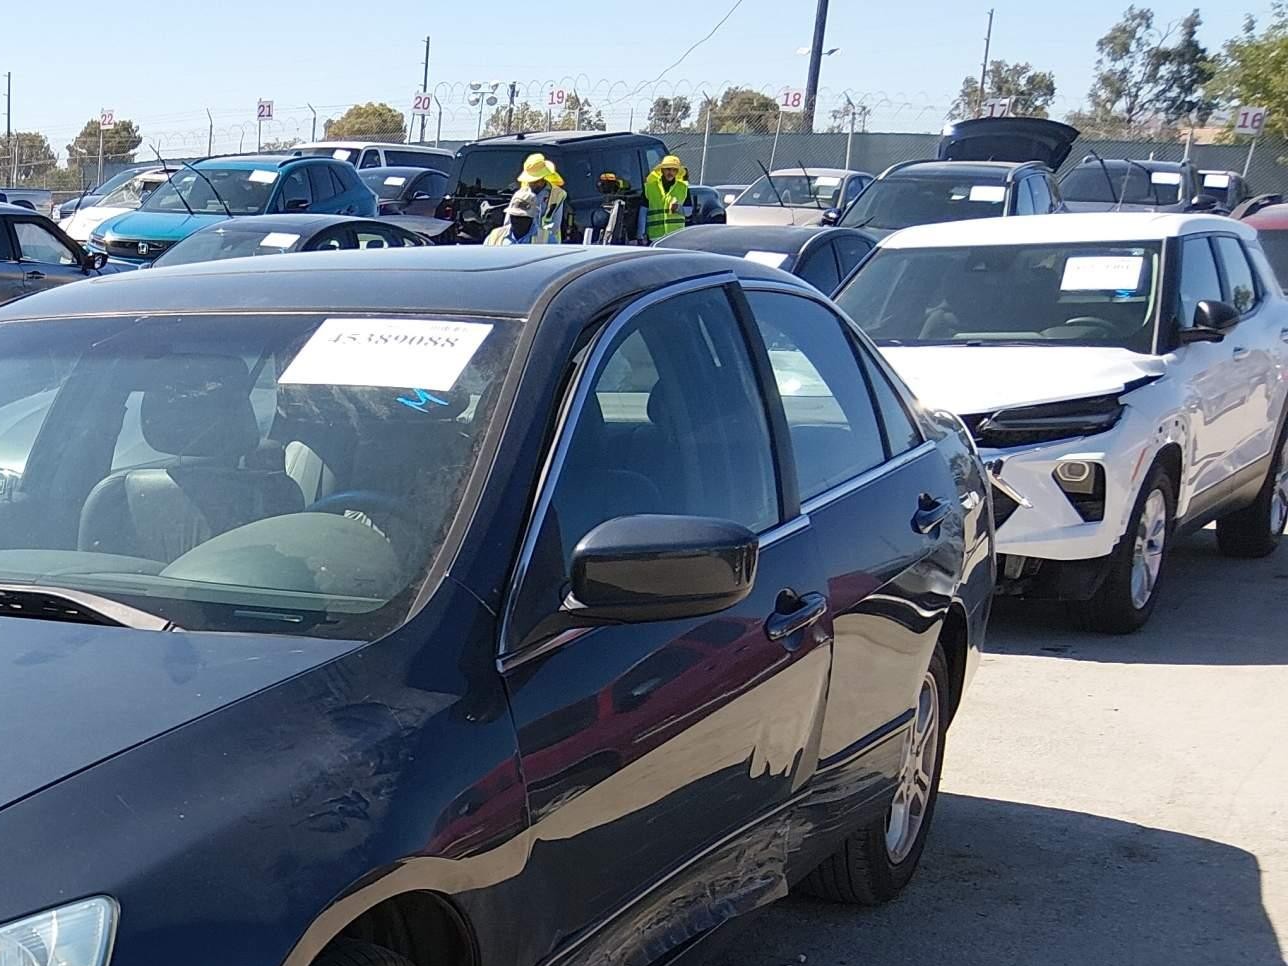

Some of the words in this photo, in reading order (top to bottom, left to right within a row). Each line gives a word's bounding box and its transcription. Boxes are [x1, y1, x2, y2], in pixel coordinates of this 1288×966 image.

[413, 95, 430, 110] 20
[548, 90, 565, 105] 19
[781, 92, 801, 108] 18
[257, 104, 273, 118] 21
[101, 113, 114, 126] 22
[1238, 112, 1262, 129] 16
